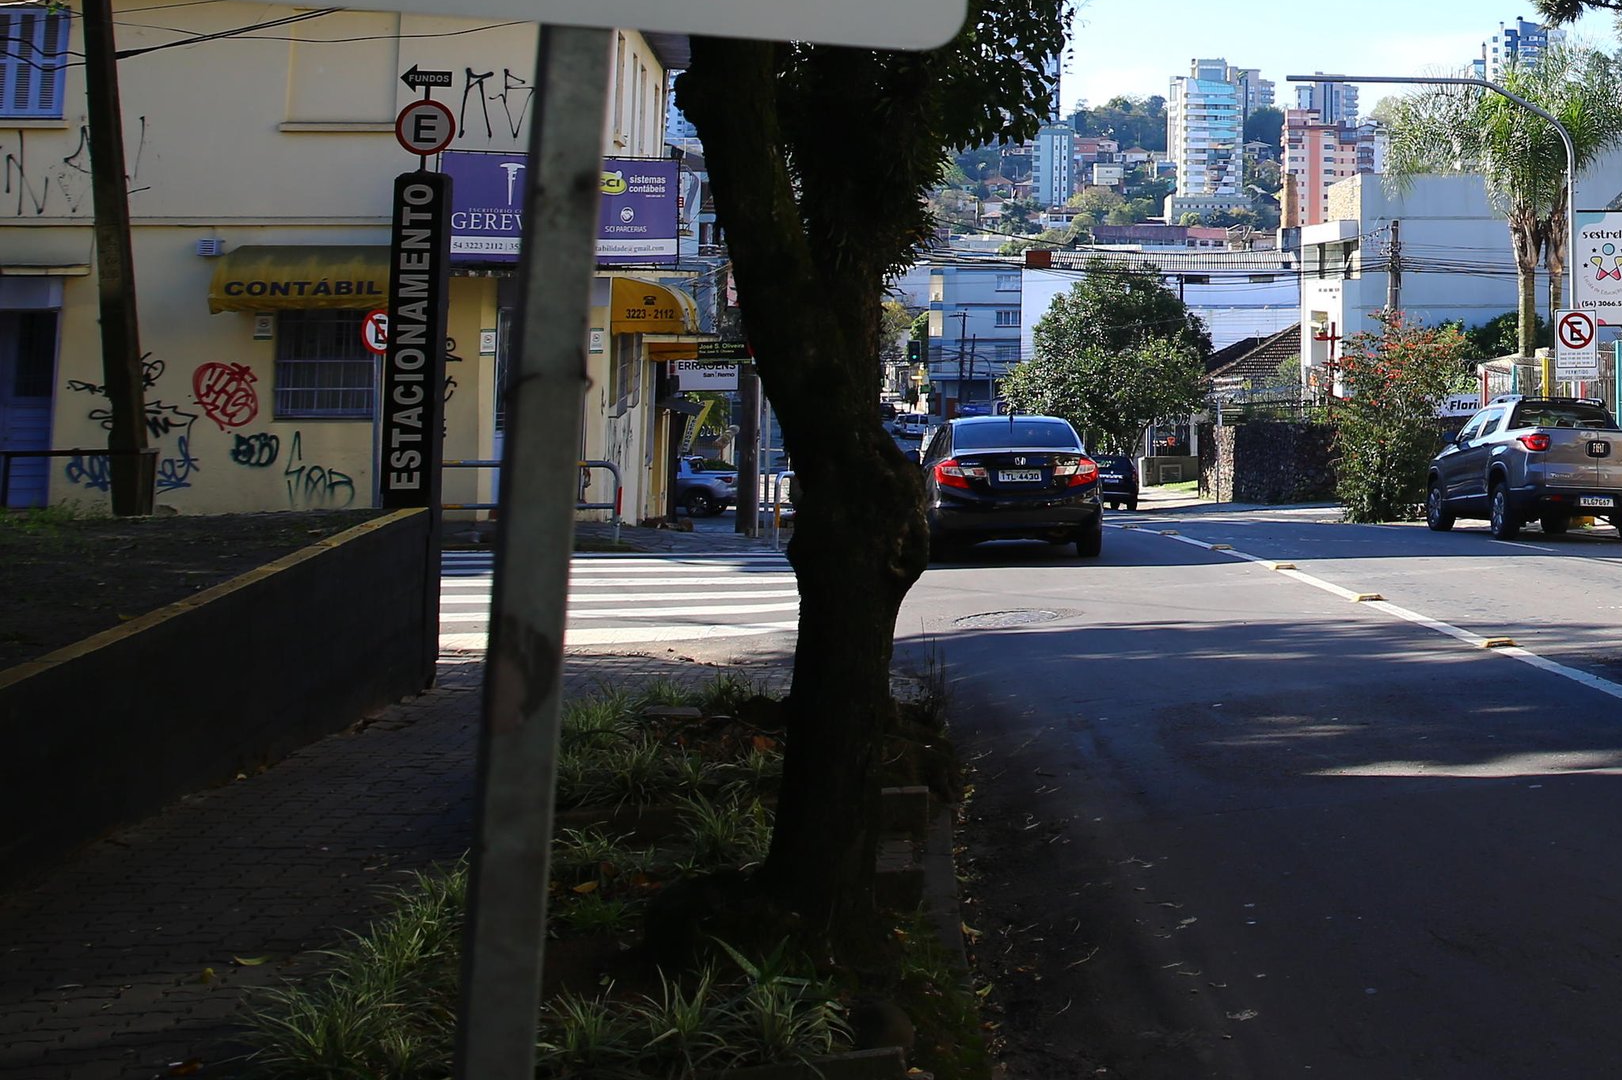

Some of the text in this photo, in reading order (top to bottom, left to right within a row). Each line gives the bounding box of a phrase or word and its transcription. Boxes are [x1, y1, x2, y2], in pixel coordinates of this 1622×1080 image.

[408, 73, 450, 84] FUNDOS
[413, 114, 438, 143] E
[629, 174, 666, 184] sistemas
[628, 184, 666, 193] contábeis
[224, 277, 383, 297] CONTÁBIL
[625, 309, 646, 319] 3223
[654, 309, 674, 319] 2112
[389, 183, 434, 490] ESTACIONAMENTO
[1450, 399, 1480, 410] Flori
